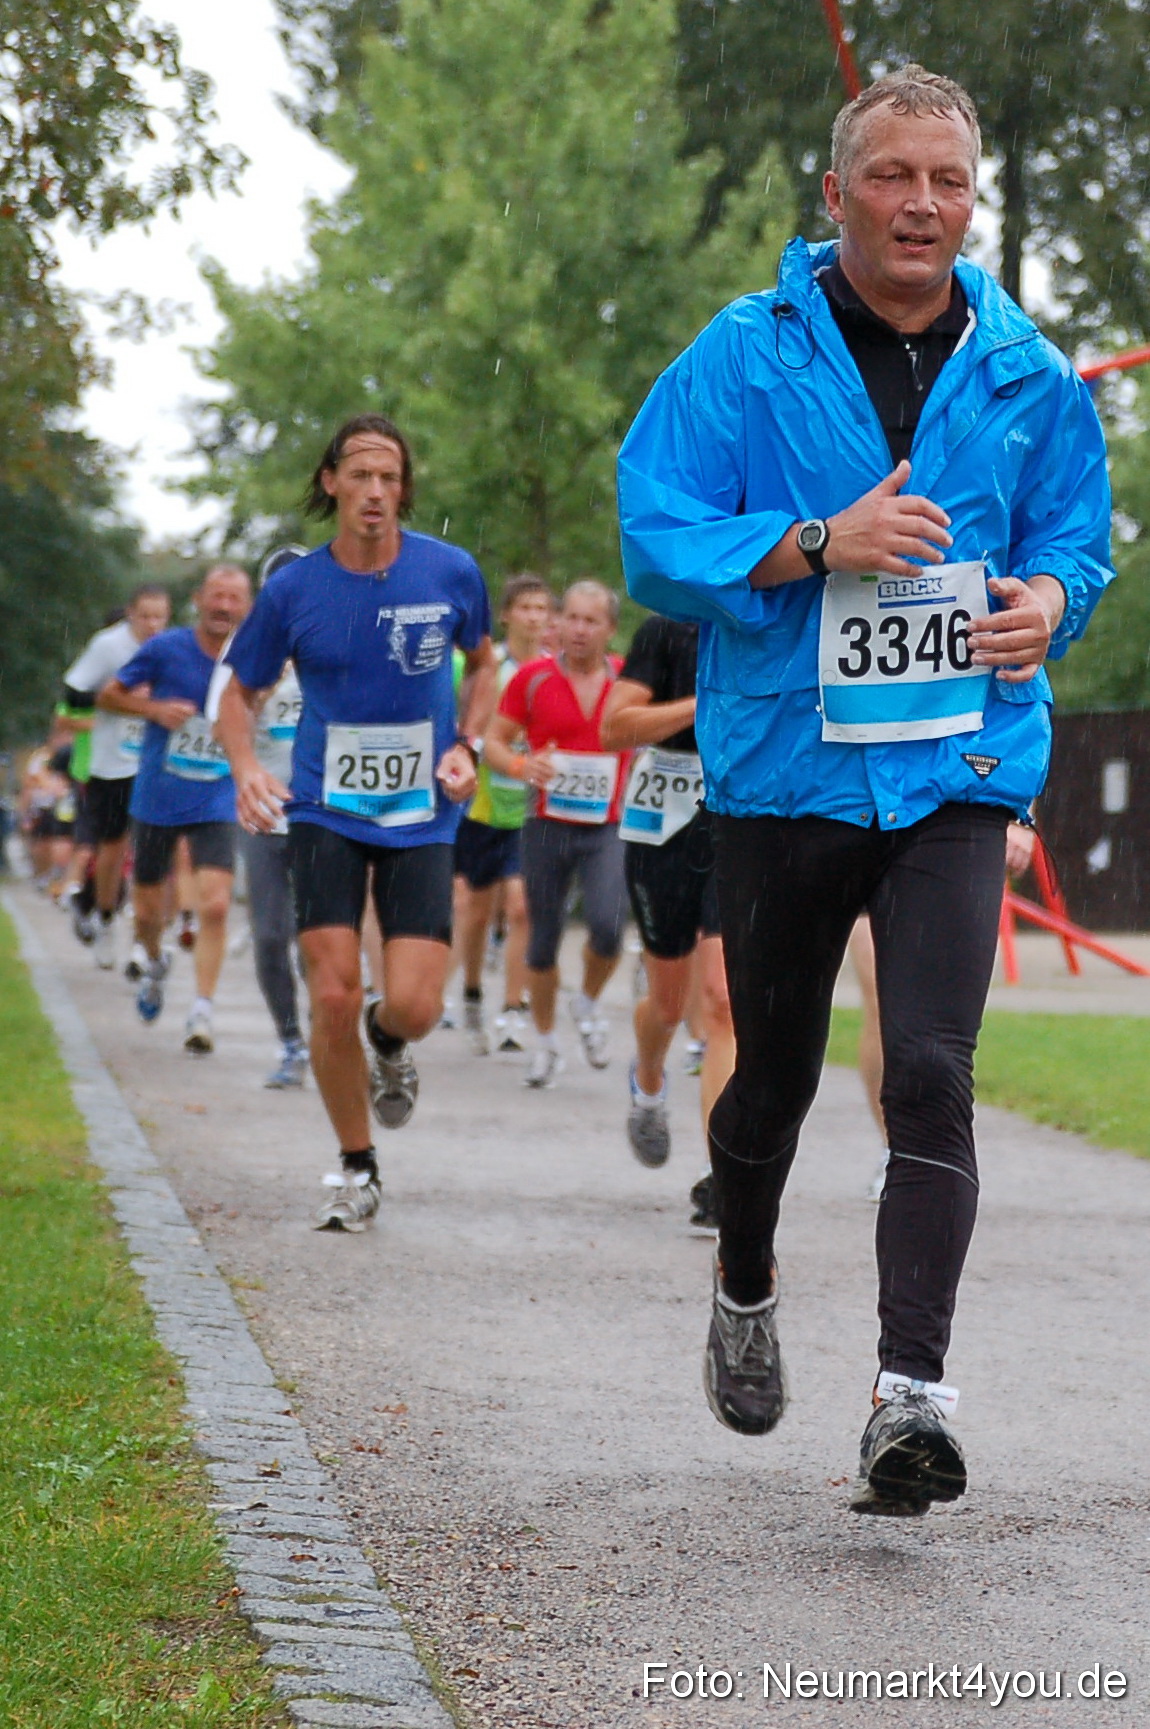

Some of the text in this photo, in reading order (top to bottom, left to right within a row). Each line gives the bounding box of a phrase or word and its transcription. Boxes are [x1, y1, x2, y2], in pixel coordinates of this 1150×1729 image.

[878, 577, 943, 598] BOCK
[838, 609, 974, 678] 3346
[338, 751, 422, 790] 2597
[553, 773, 609, 798] 2298
